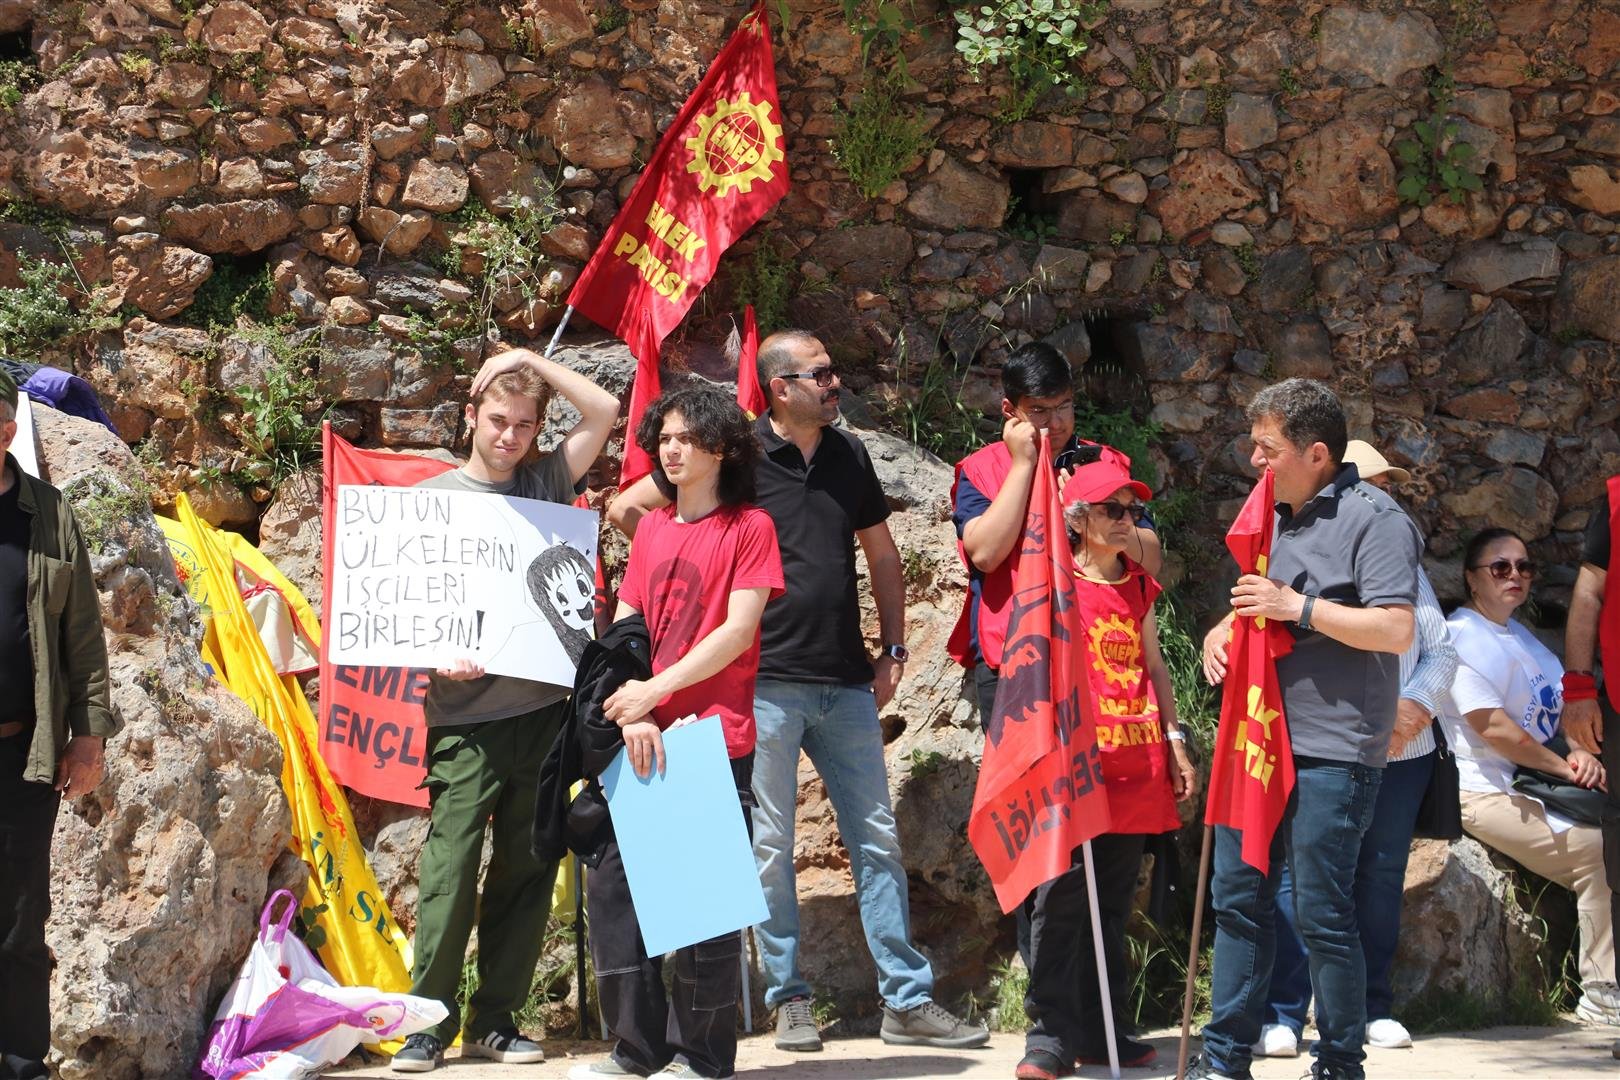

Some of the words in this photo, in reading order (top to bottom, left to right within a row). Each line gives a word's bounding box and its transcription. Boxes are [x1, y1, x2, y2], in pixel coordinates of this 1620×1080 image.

[710, 121, 760, 166] EMEP
[645, 200, 708, 263] EMEK
[344, 488, 450, 525] BÜTÜN
[341, 530, 514, 573] ÜLKELERİN
[346, 572, 465, 610] İŞÇİLERİ
[334, 664, 431, 705] EME
[325, 703, 428, 769] ENÇL
